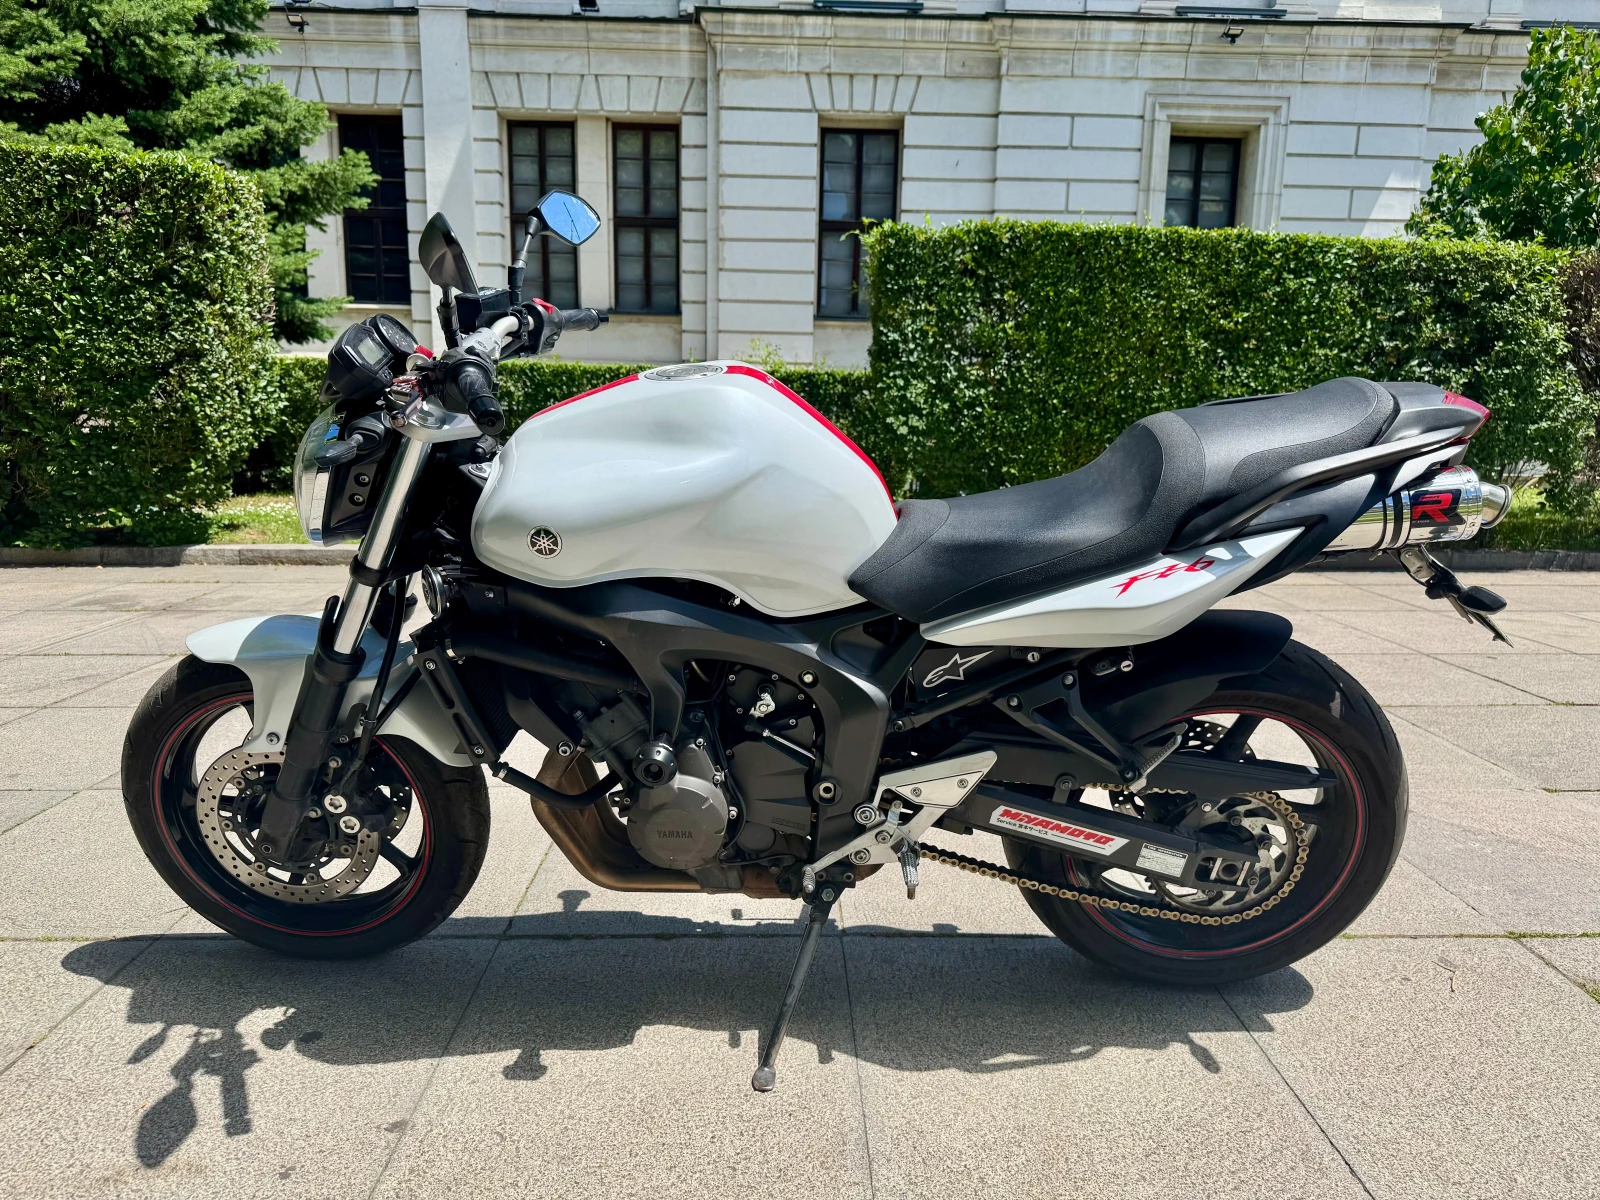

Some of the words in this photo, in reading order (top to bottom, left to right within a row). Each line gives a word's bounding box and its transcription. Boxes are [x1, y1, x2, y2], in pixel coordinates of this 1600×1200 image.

[1412, 493, 1452, 522] R
[997, 817, 1017, 827] Service
[656, 830, 693, 839] YAMAHA
